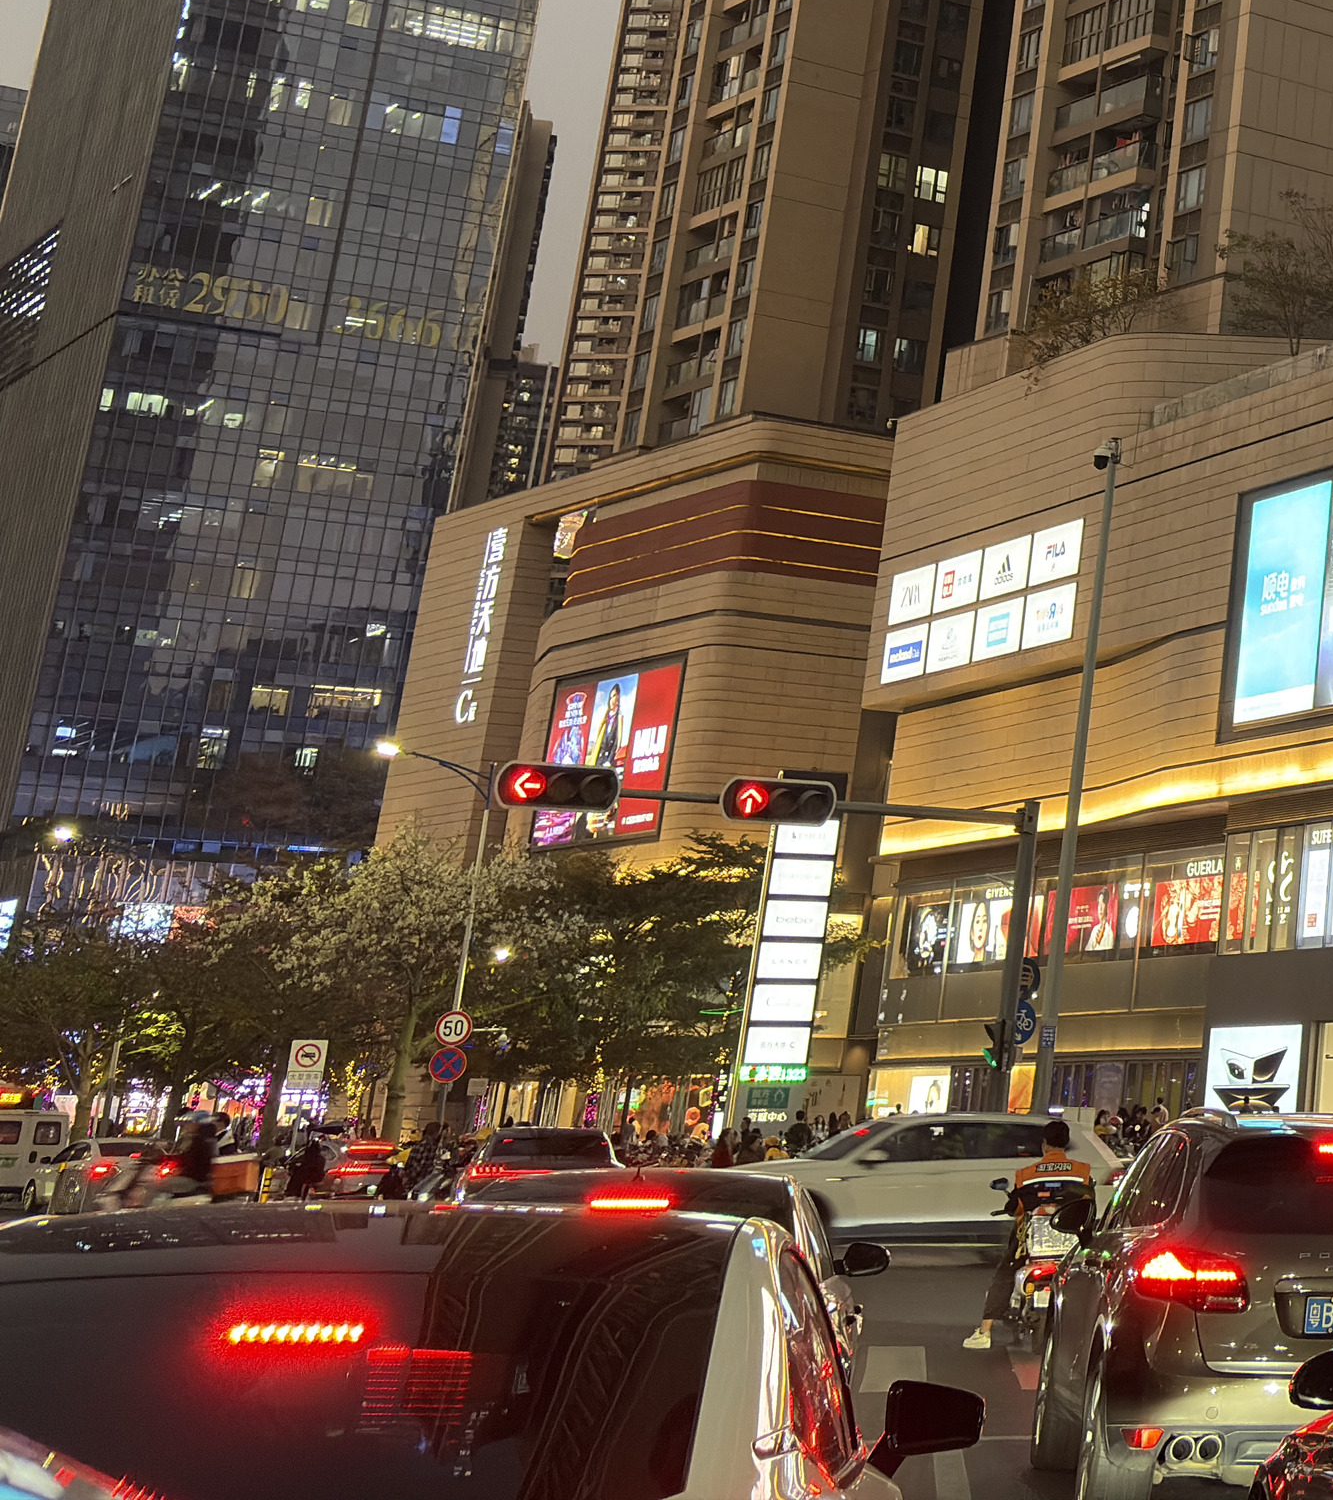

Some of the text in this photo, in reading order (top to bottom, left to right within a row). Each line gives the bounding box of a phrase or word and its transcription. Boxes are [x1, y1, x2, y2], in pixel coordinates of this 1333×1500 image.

[1045, 541, 1066, 560] FILA
[468, 527, 508, 674] 壹方天地
[1187, 859, 1223, 877] GUERLA
[986, 887, 1015, 900] GIVENC
[443, 1020, 464, 1037] 50
[1037, 1162, 1072, 1172] 淘宝闪购
